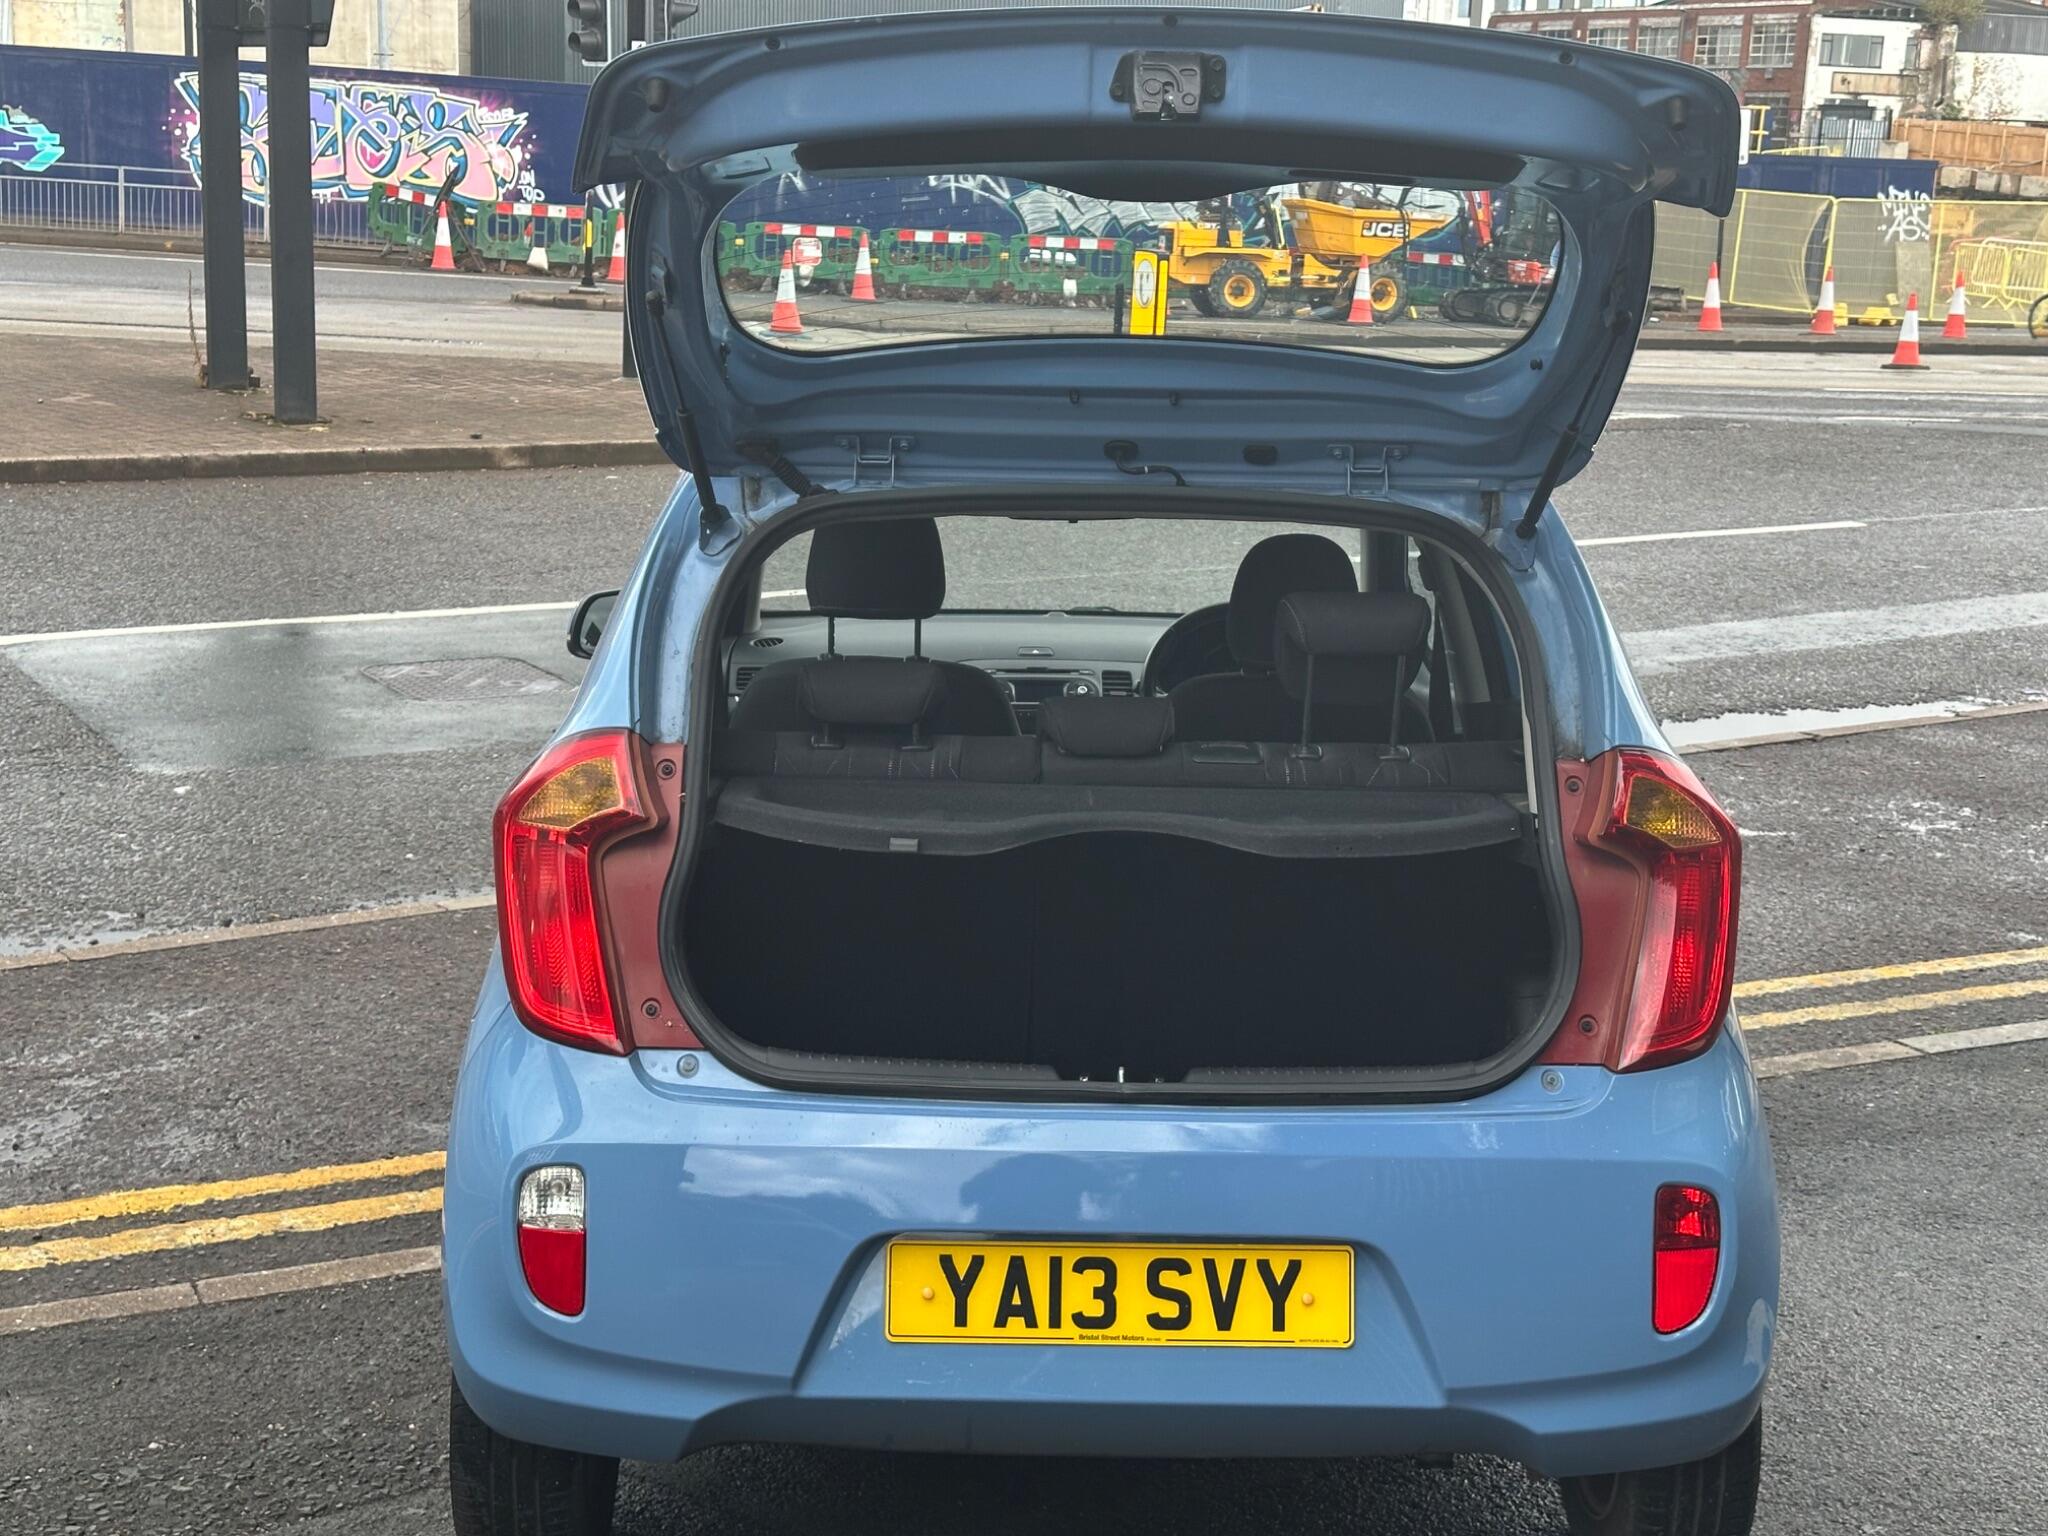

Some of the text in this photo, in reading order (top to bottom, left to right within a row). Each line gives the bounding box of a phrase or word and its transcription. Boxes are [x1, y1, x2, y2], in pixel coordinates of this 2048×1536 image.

[1362, 222, 1408, 237] JCB
[939, 1254, 1302, 1332] YA13 SVY
[1078, 1333, 1099, 1341] Bristol
